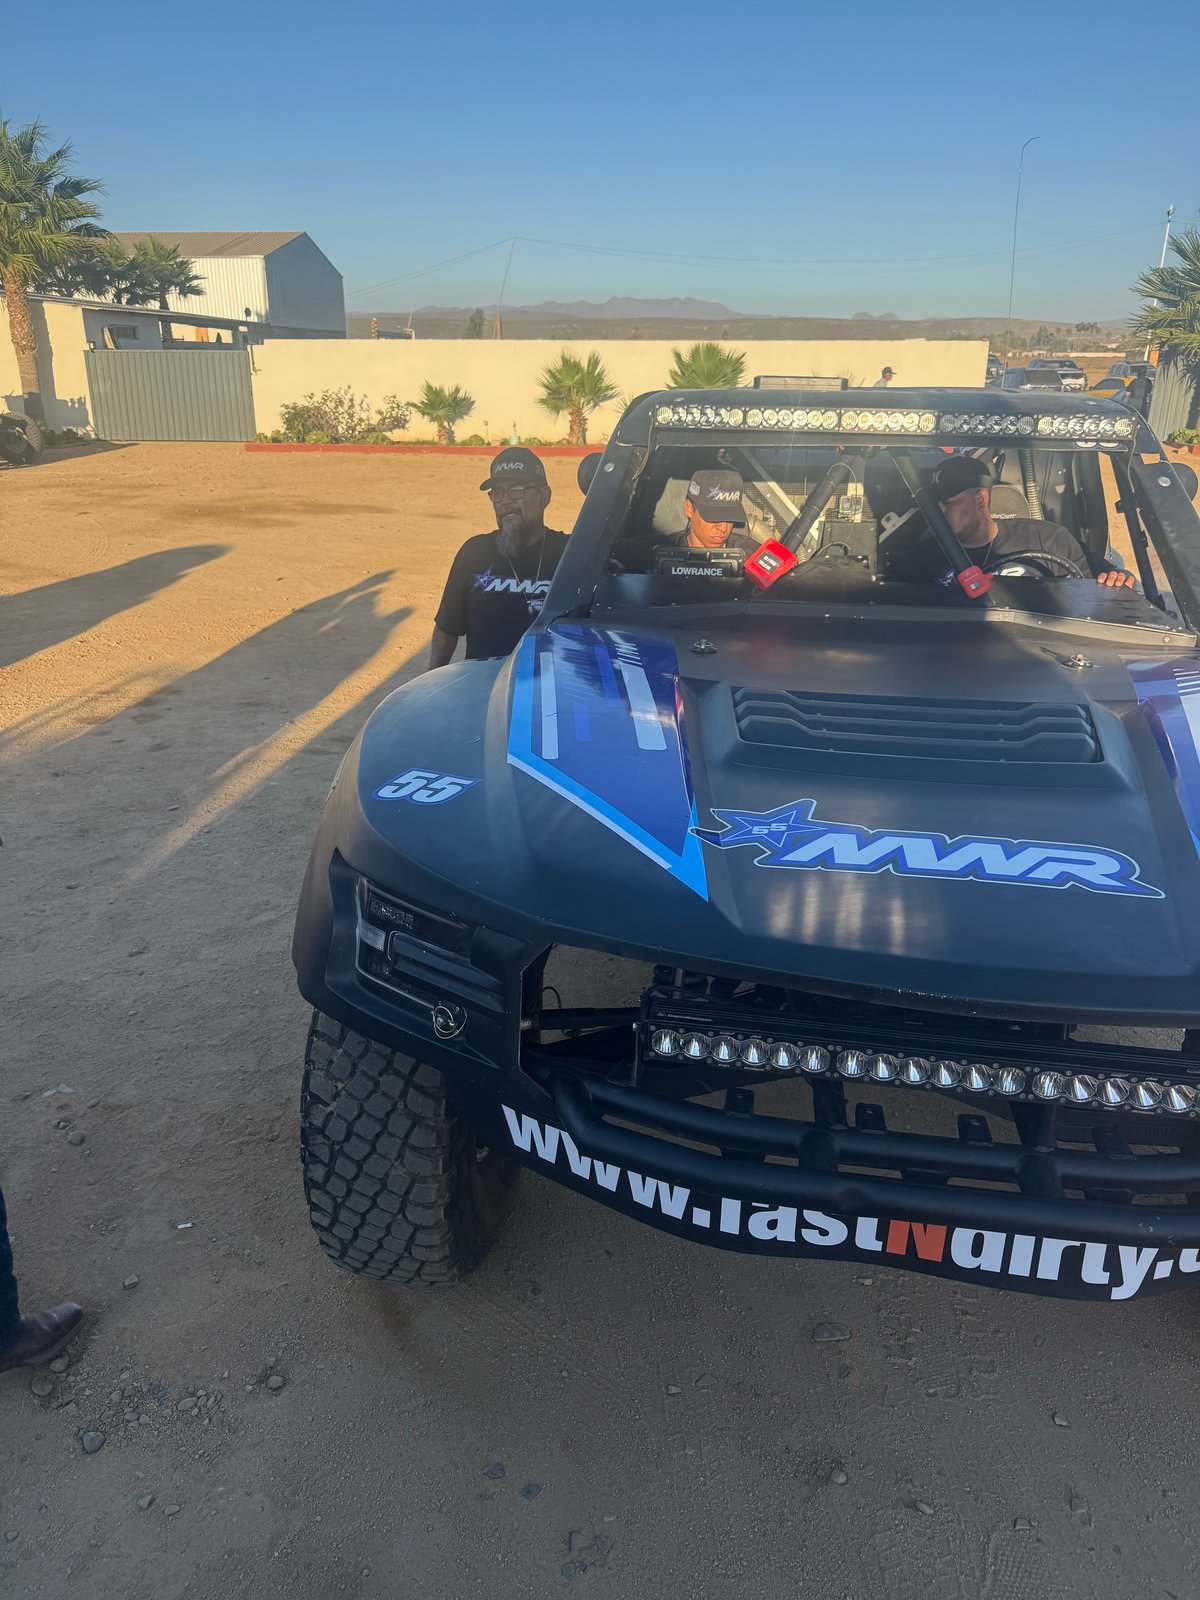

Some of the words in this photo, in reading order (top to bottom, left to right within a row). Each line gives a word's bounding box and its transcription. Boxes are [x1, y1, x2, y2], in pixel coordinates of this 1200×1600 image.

[671, 566, 724, 577] LOWRANCE
[375, 769, 477, 804] 55
[779, 831, 1133, 888] MWR
